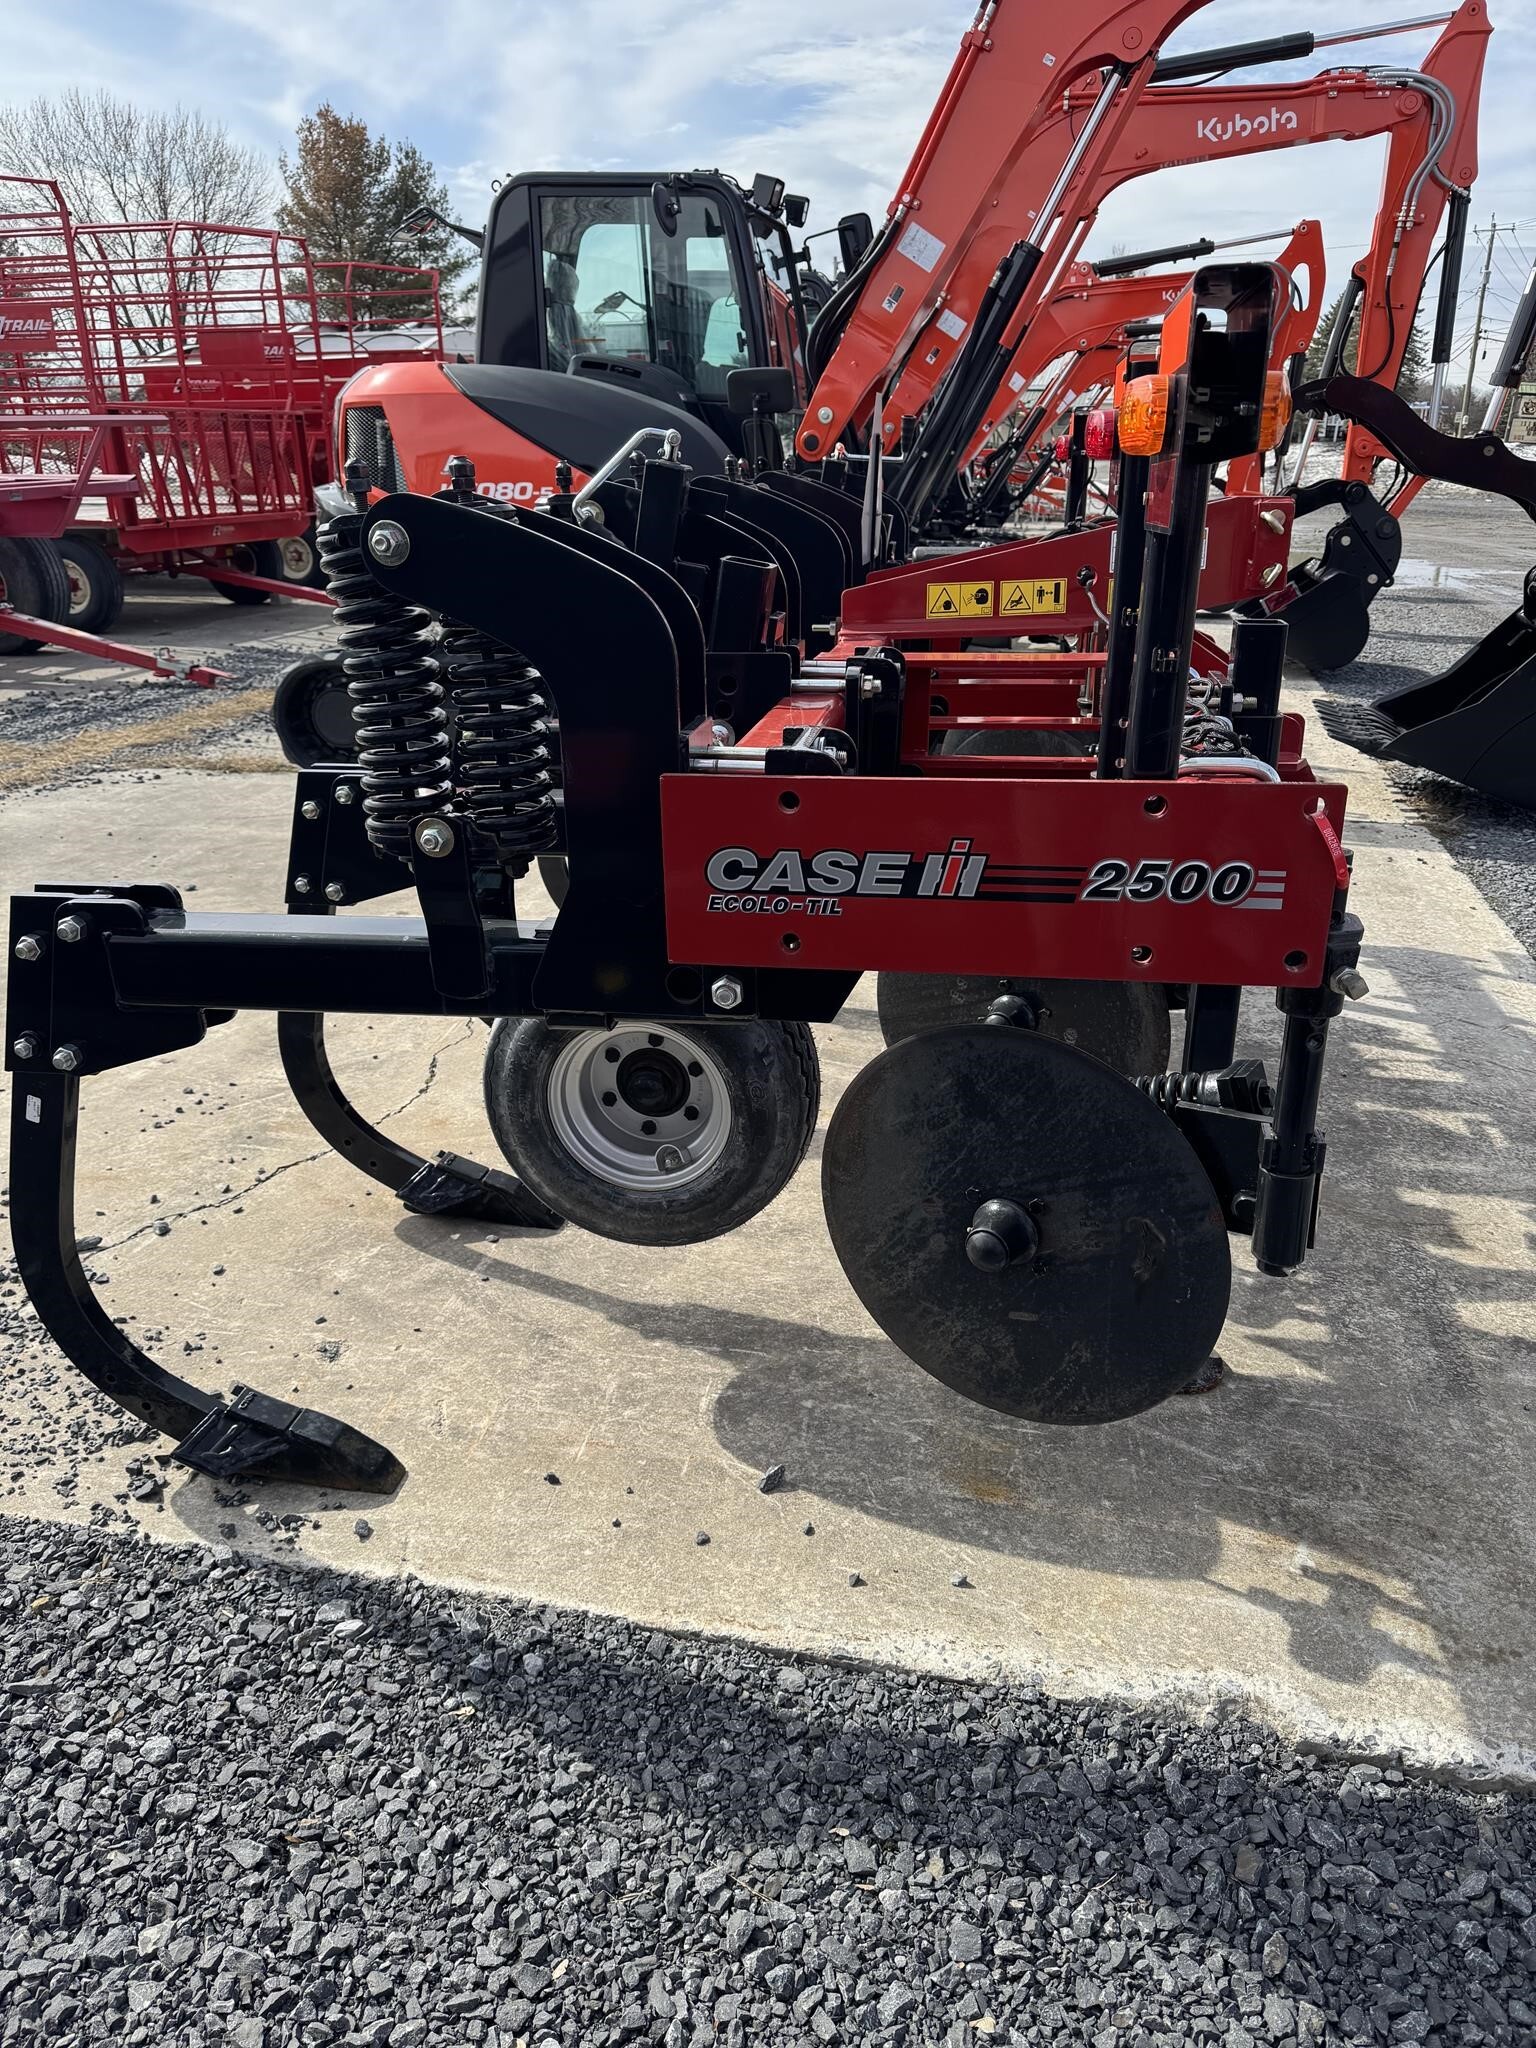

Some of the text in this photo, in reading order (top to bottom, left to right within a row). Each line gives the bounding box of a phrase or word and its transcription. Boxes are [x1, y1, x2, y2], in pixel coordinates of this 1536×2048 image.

[1197, 106, 1297, 142] Kubota
[4, 319, 52, 331] TRAIL
[706, 847, 911, 895] CASE
[1080, 857, 1254, 905] 2500
